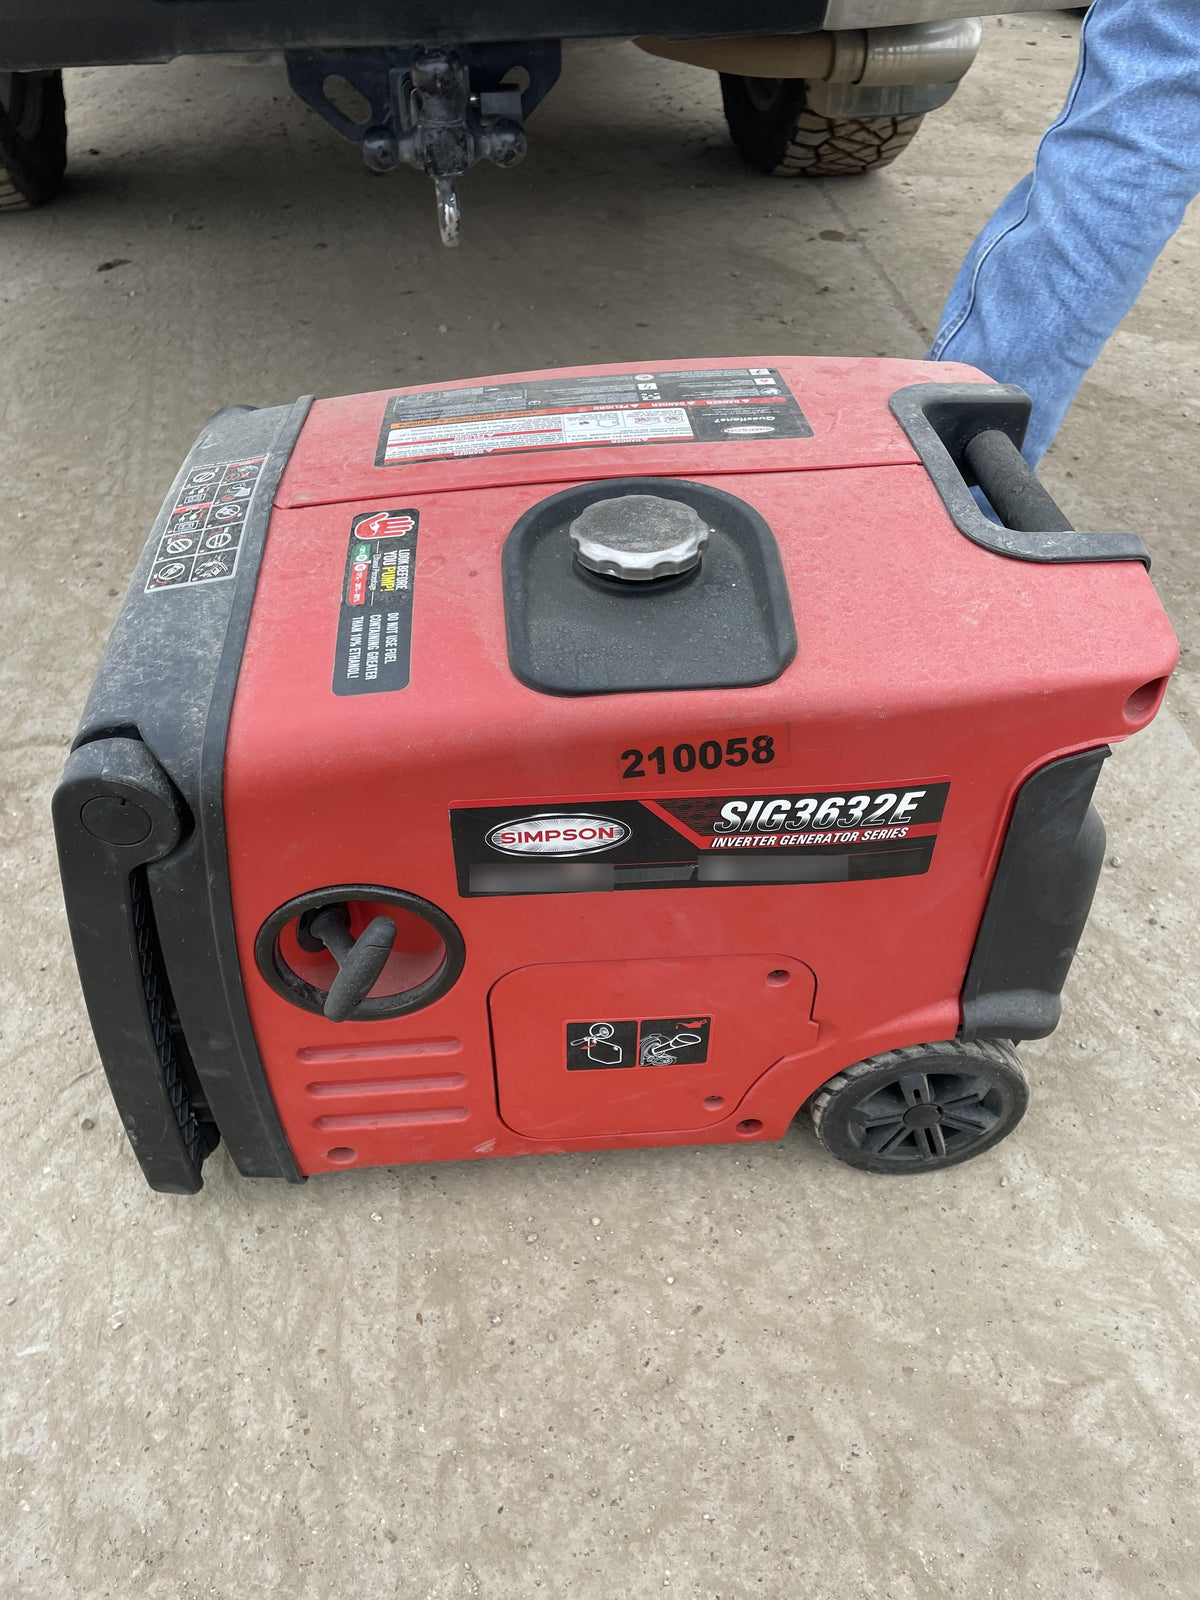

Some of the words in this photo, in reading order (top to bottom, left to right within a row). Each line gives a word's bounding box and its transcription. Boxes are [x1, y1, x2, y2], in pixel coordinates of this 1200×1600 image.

[382, 550, 398, 566] YOU
[397, 549, 410, 565] LOOK
[380, 566, 396, 592] PUMP!
[395, 565, 409, 590] BEFORE
[351, 615, 364, 633] THAN
[387, 612, 400, 622] DO
[367, 614, 382, 650] CONTAINING
[385, 621, 399, 634] NOT
[349, 633, 362, 647] 10%
[385, 634, 398, 648] USE
[346, 647, 361, 679] ETHANOL!
[384, 648, 397, 665] FUEL
[364, 651, 379, 681] GREATER
[620, 735, 775, 779] 210058
[713, 790, 927, 833] SIG3632E
[500, 827, 615, 844] SIMPSON
[711, 835, 777, 848] INVERTER
[779, 831, 859, 846] GENERATOR
[861, 827, 909, 841] SERIES
